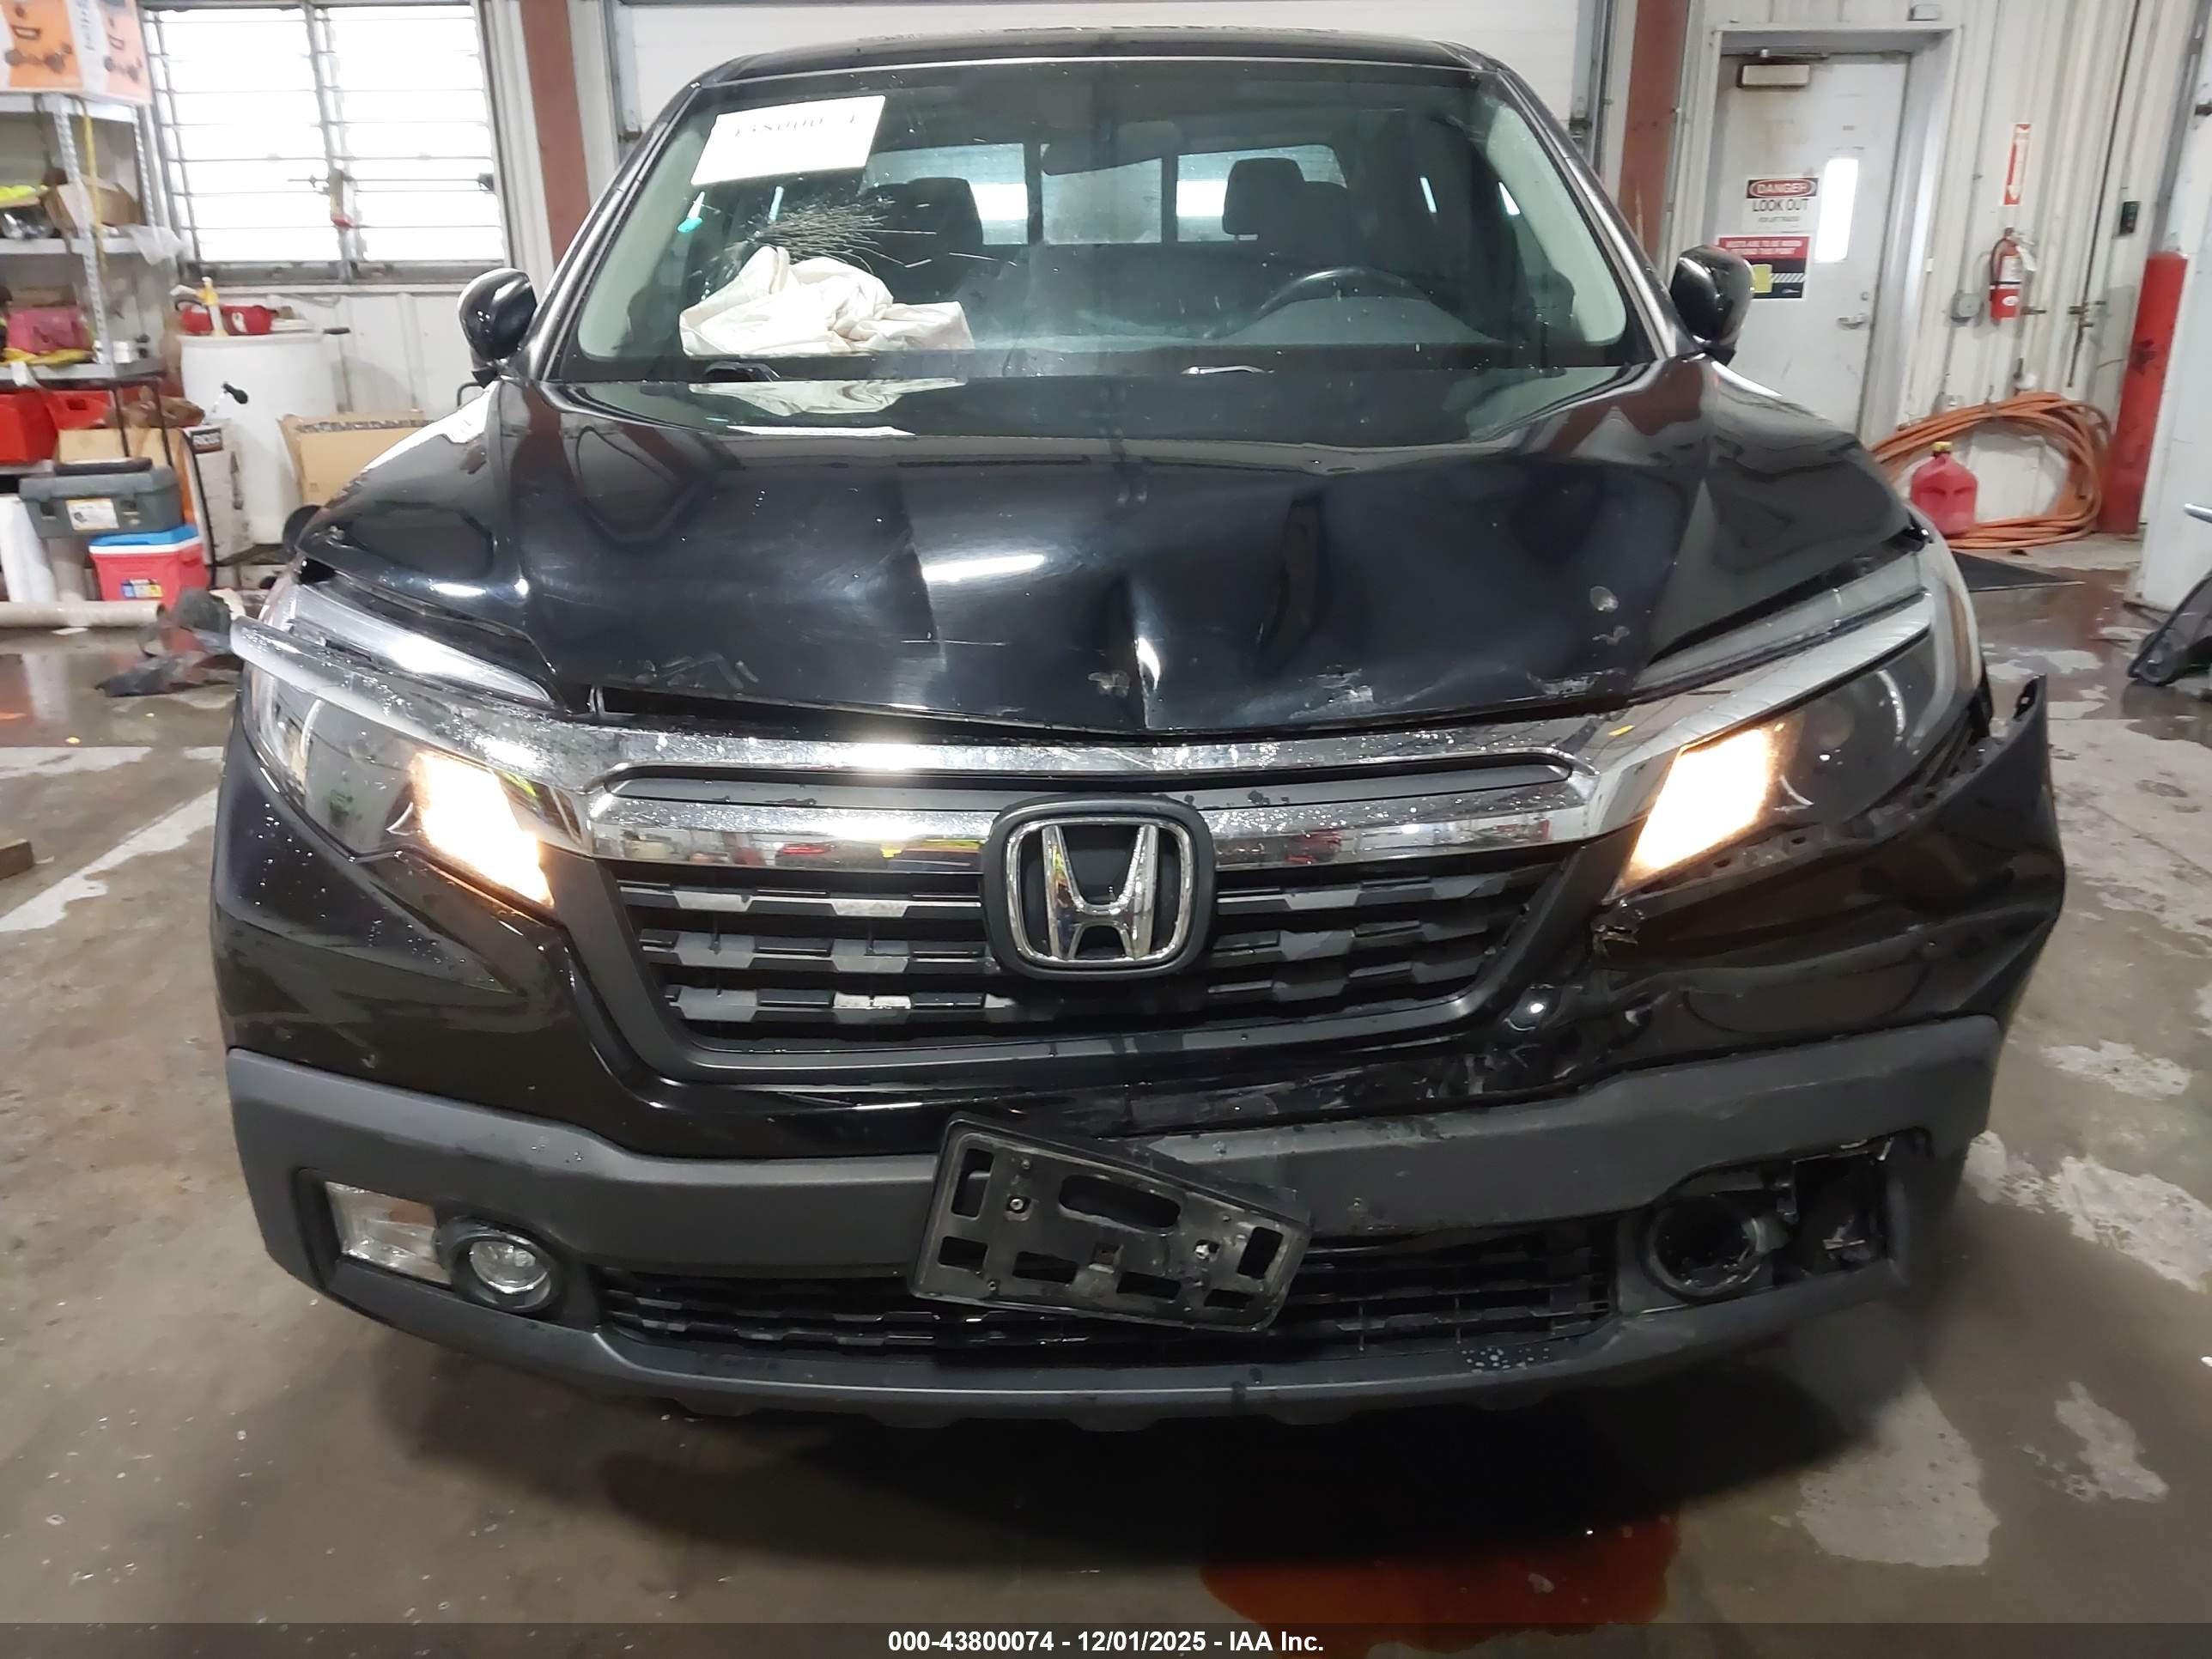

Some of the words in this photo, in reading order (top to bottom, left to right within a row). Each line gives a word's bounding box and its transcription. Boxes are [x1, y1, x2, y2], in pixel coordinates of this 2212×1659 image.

[1757, 183, 1808, 194] DANGER
[1753, 198, 1784, 212] LOOK
[1786, 198, 1809, 211] OUT
